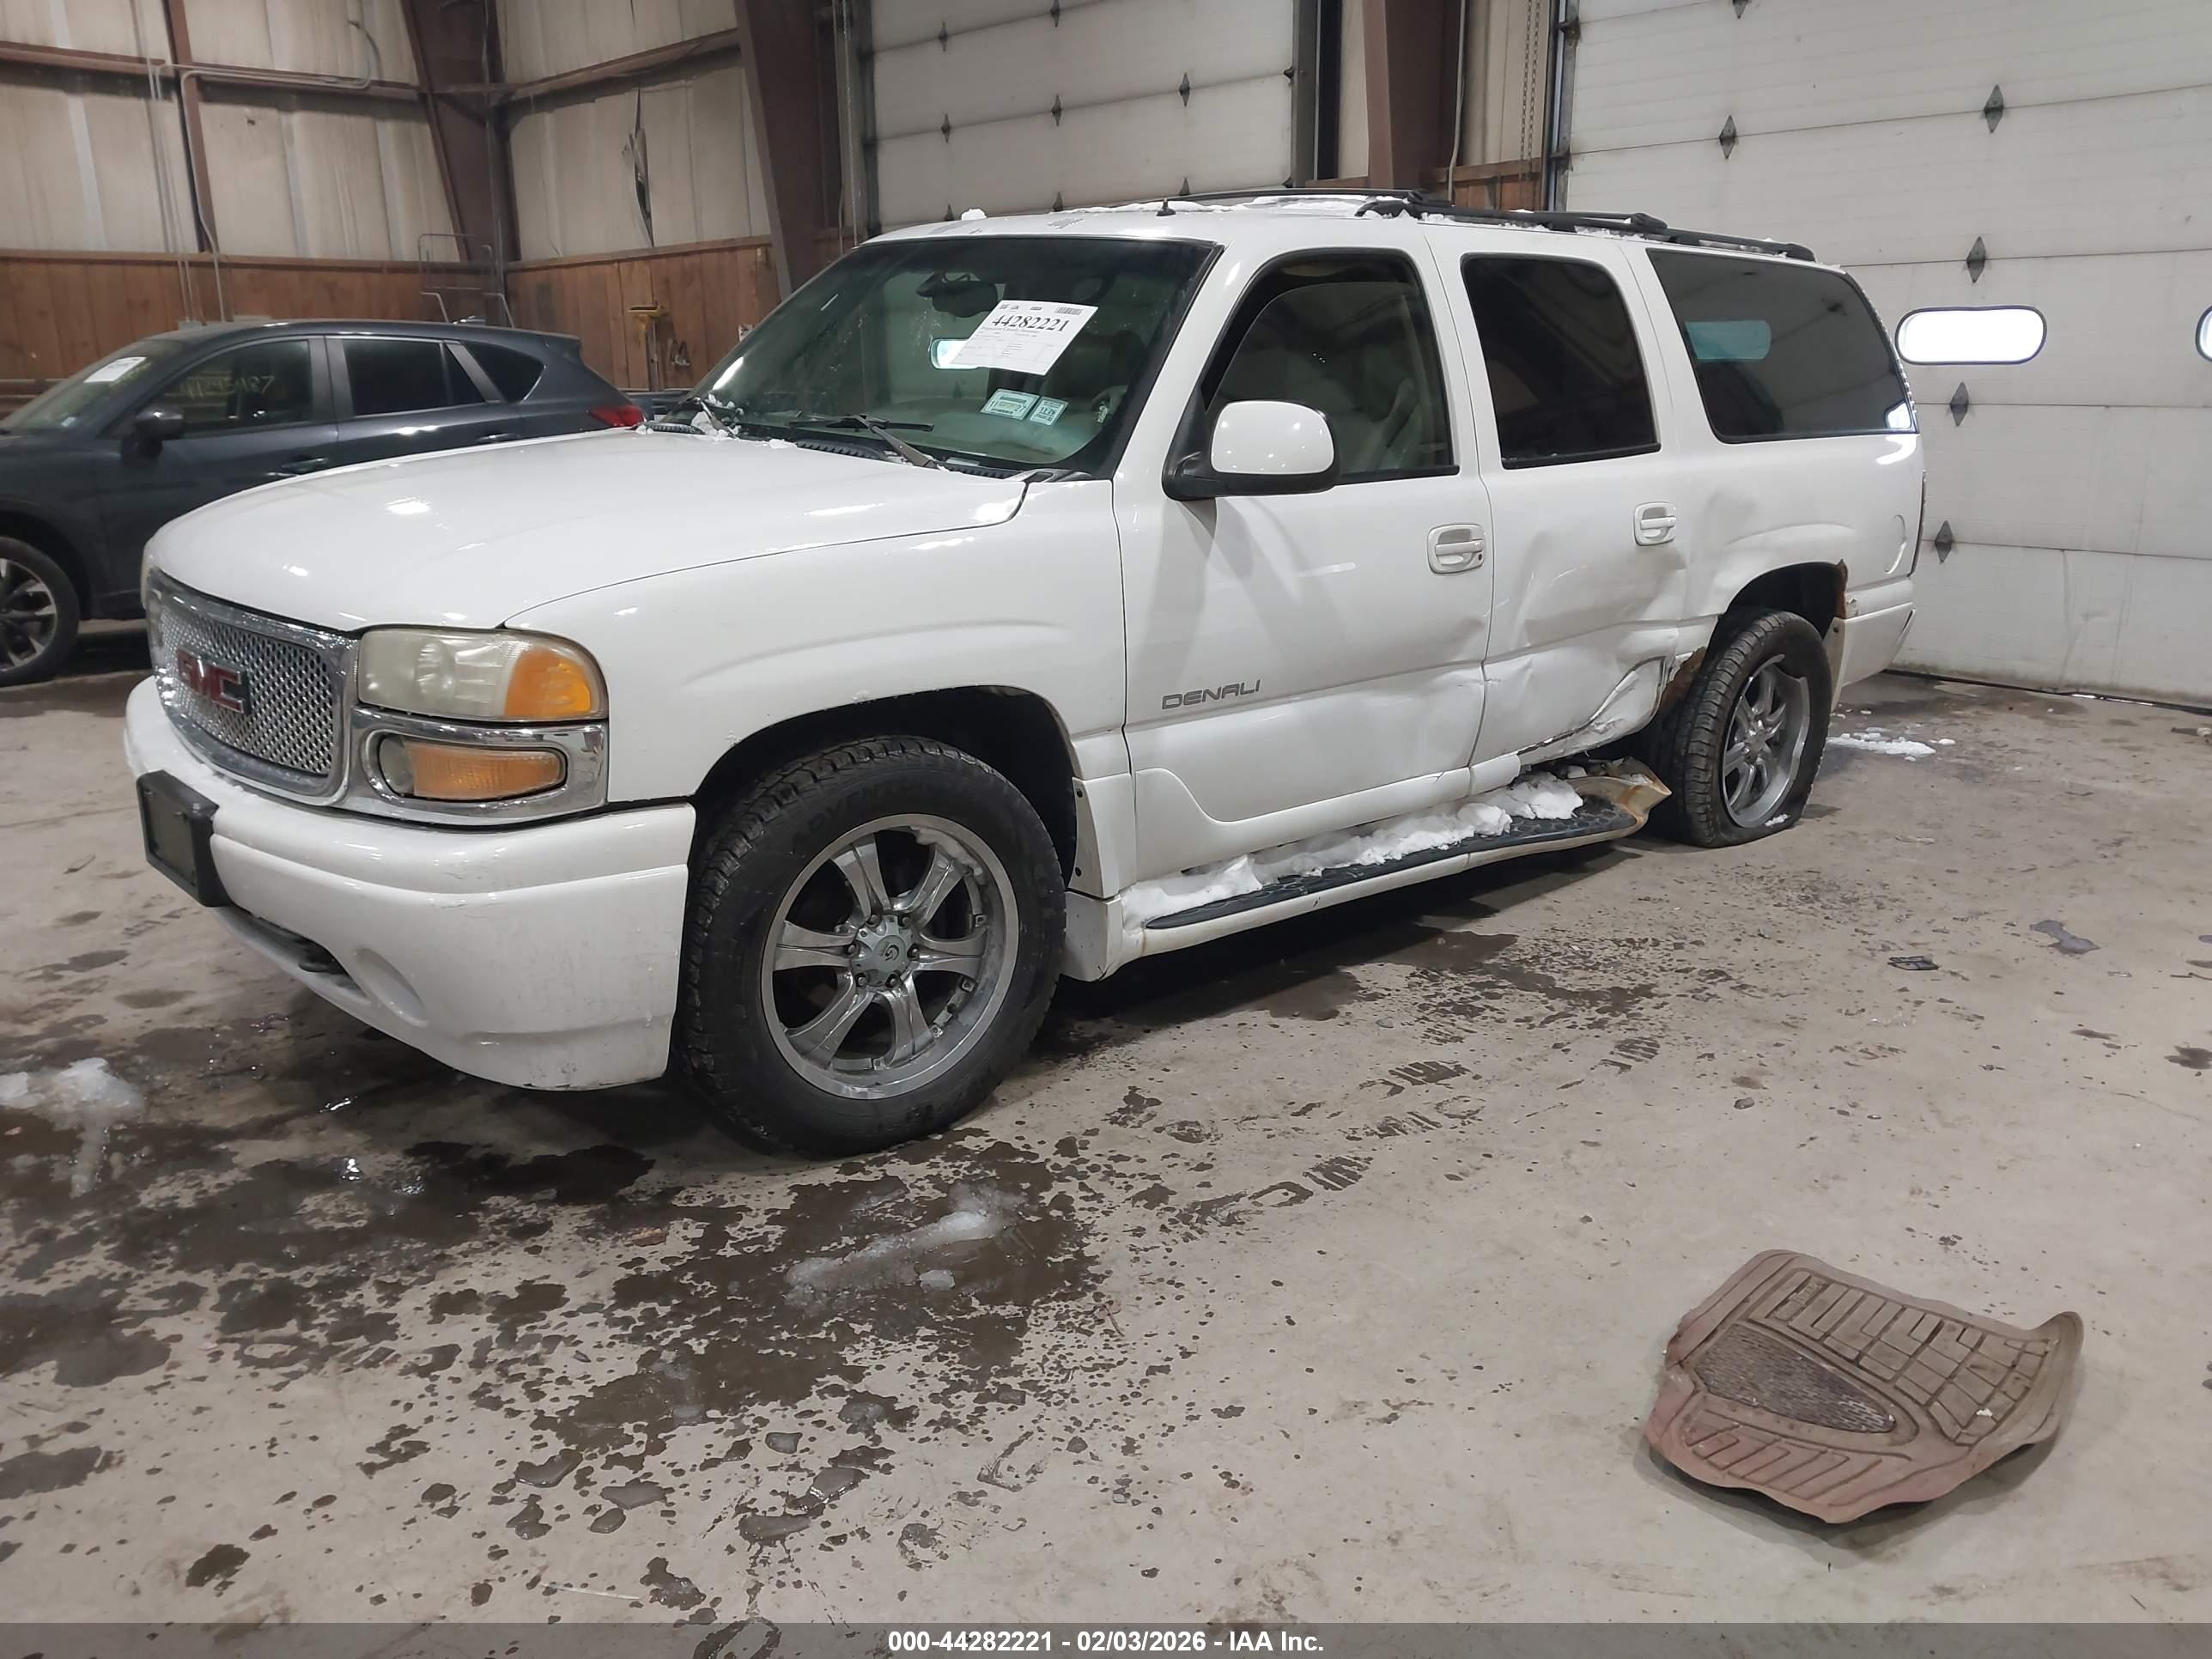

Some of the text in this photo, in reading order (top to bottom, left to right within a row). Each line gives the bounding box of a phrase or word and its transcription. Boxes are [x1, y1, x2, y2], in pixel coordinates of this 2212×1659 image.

[992, 314, 1070, 331] 44282221
[176, 647, 245, 714] GMC
[1161, 679, 1261, 710] DENALI
